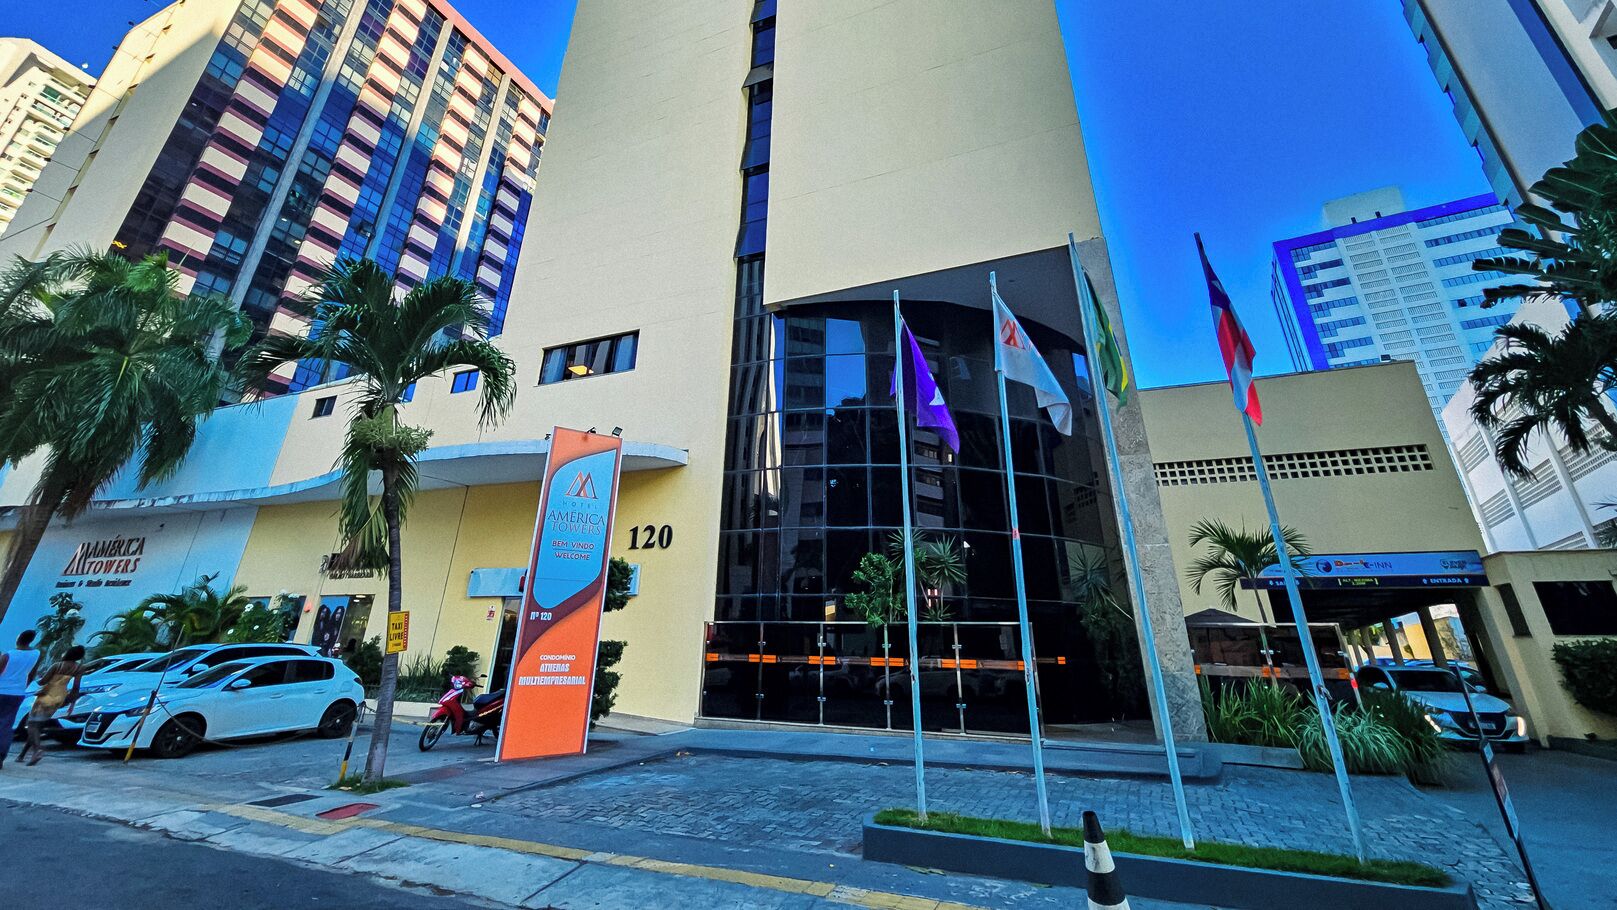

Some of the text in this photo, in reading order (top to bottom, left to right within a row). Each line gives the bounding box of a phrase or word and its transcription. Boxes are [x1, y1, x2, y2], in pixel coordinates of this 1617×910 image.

[548, 510, 605, 526] AMÉRICA
[551, 520, 602, 536] TOWERS
[628, 524, 673, 550] 120
[551, 540, 595, 550] BEM VINDO
[554, 552, 591, 560] WELCOME
[86, 558, 141, 575] TOWERS
[540, 612, 552, 621] 120
[391, 622, 403, 631] TAXI
[389, 631, 404, 641] LIVRE
